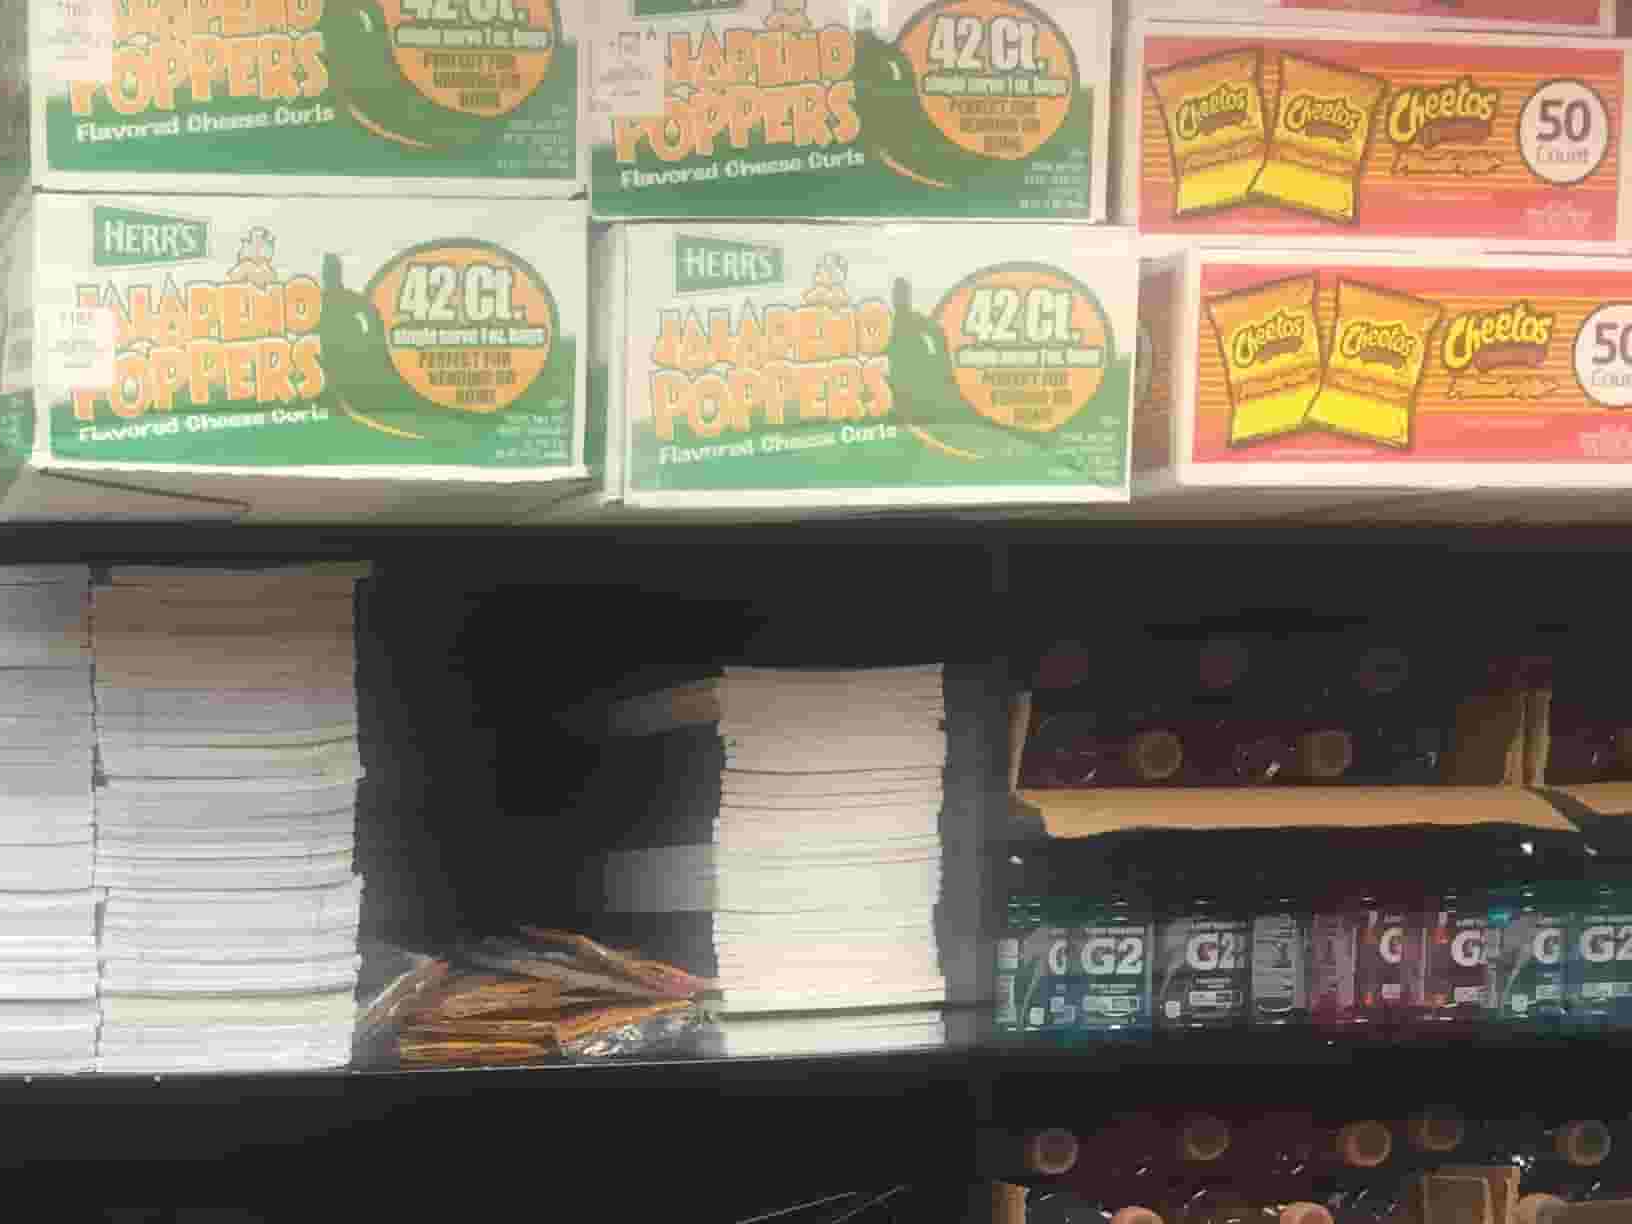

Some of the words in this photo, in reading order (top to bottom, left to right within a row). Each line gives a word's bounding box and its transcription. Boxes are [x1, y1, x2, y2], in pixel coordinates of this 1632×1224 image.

[930, 16, 981, 69] 42
[1386, 76, 1496, 144] Cheetos
[1536, 98, 1592, 142] 50
[620, 163, 718, 190] Flavored
[724, 156, 801, 180] Cheese
[808, 149, 864, 170] Curls
[399, 265, 456, 322] 42
[464, 264, 529, 322] Ct.
[962, 288, 1017, 341] 42
[1025, 288, 1081, 342] Ct.
[1232, 310, 1306, 368] Cheetos
[1440, 302, 1554, 369] Cheetos
[650, 357, 895, 440] POPPERS
[1081, 936, 1144, 975] G2
